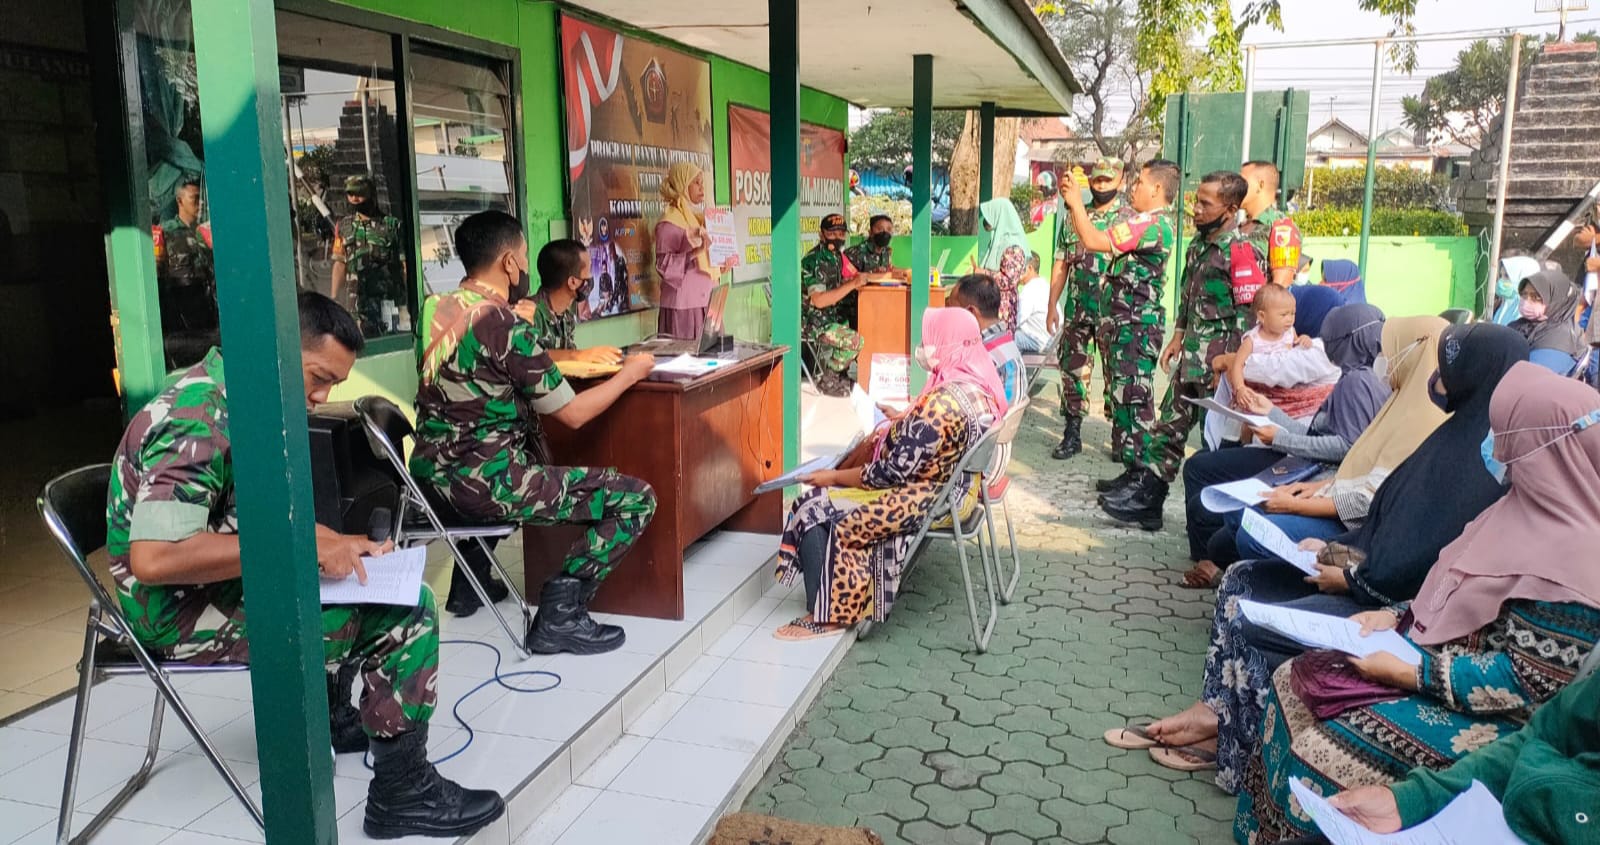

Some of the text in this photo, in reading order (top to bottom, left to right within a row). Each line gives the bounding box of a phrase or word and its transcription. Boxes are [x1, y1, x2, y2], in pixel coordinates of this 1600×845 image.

[590, 139, 632, 159] PROGRAM
[634, 144, 668, 167] BANTUAN
[735, 169, 771, 205] POSK
[609, 199, 641, 216] KODIM
[747, 217, 771, 236] KORAM
